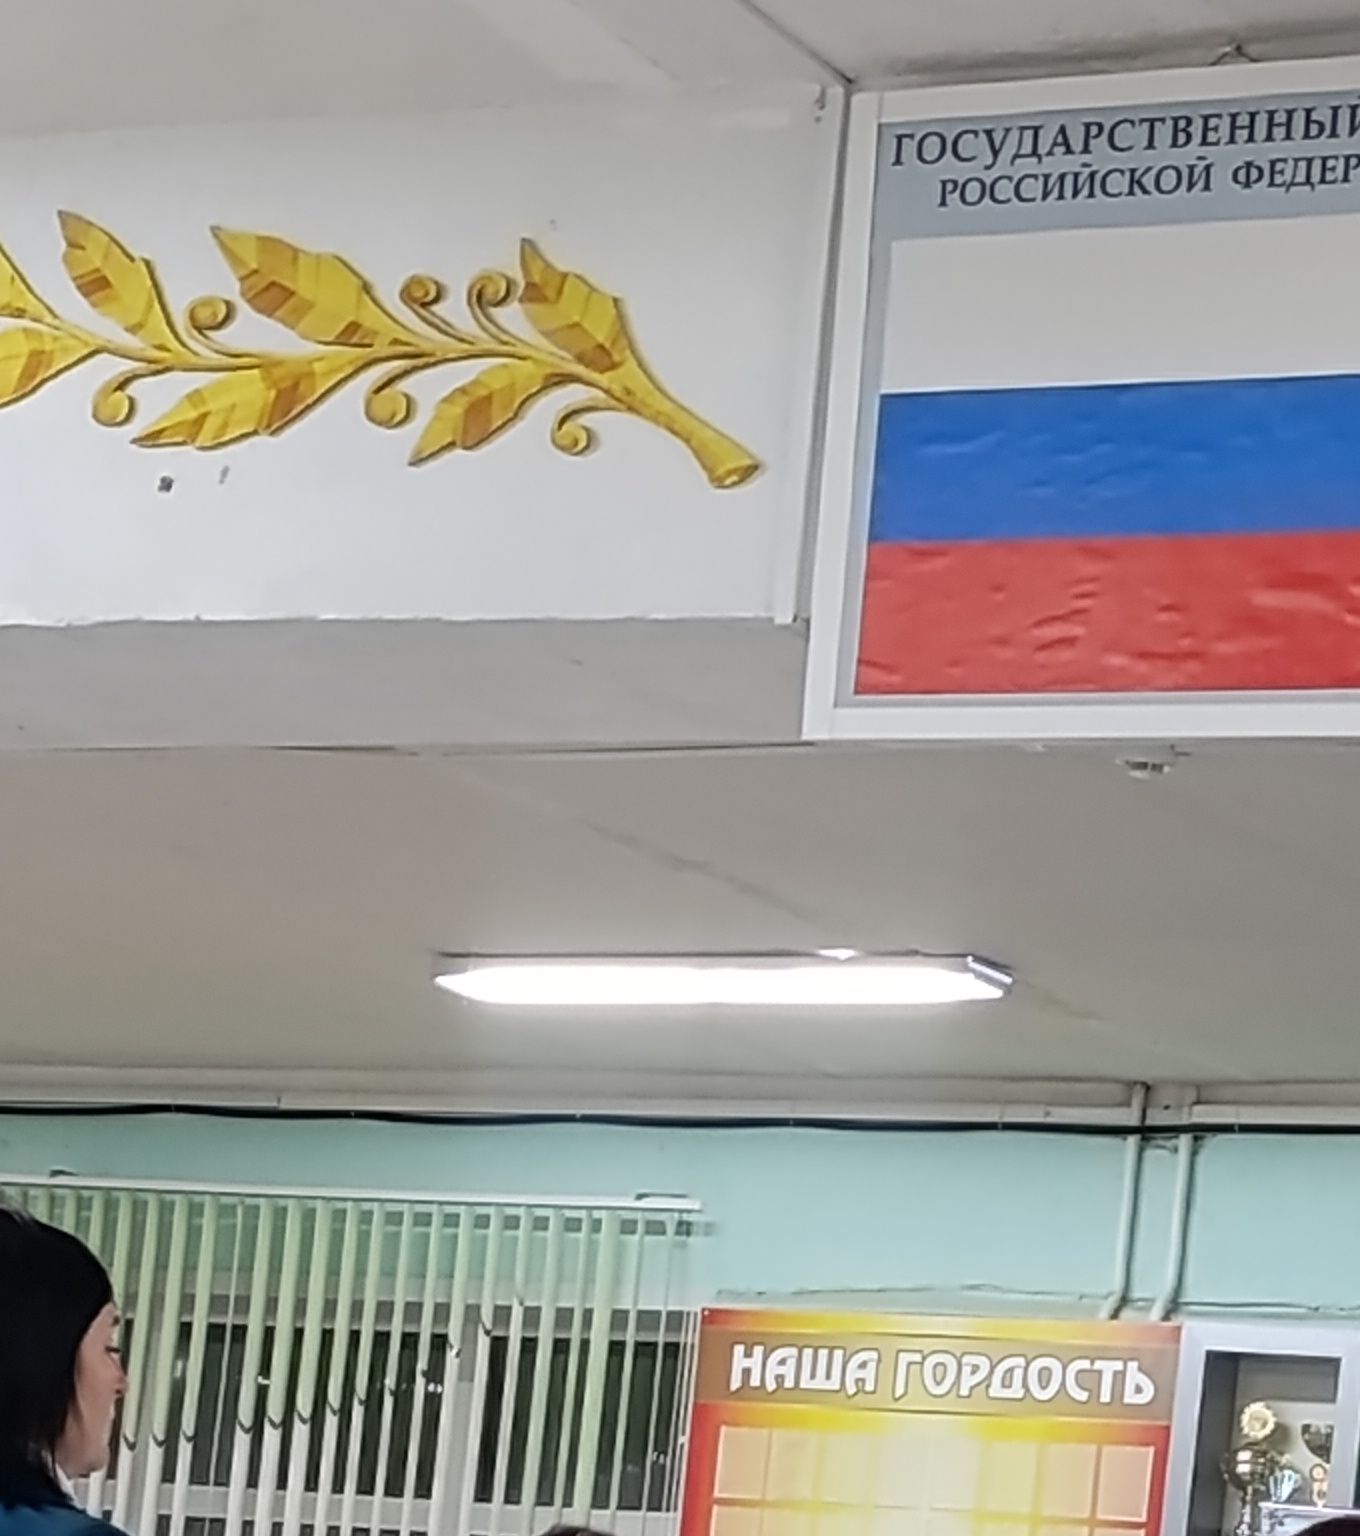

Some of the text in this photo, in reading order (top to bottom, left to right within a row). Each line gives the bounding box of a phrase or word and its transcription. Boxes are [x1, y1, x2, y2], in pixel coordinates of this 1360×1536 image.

[937, 155, 1215, 208] РОССИЙСКОЙ
[729, 1343, 1157, 1405] НАША ГОРДОСТЬ
